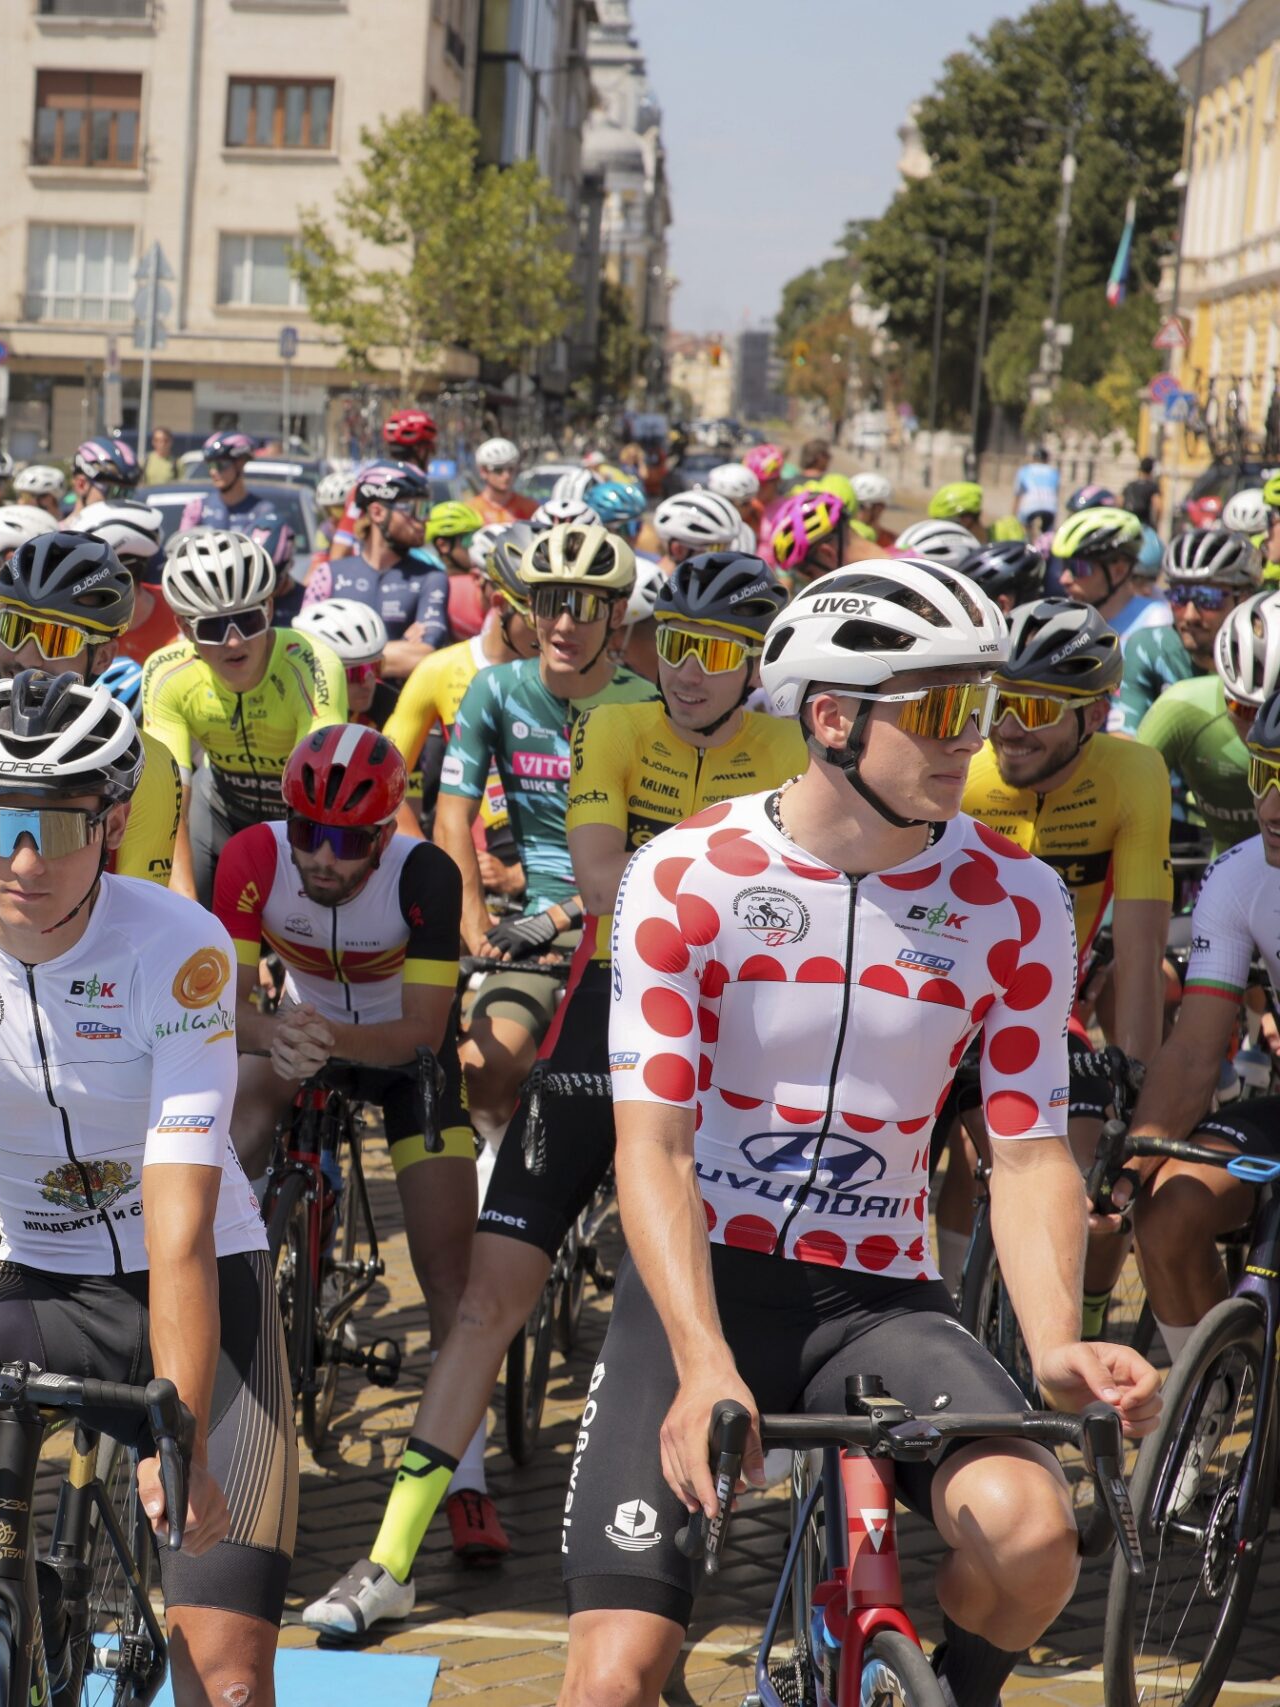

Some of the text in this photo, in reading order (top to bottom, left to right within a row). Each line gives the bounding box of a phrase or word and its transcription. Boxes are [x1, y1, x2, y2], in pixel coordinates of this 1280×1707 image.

[812, 596, 876, 618] uvex
[979, 643, 999, 653] uvex
[518, 755, 570, 780] VITO
[640, 776, 680, 799] KALINEL
[630, 794, 677, 816] Continental
[894, 922, 969, 944] Bulgarian Cycling Federation
[898, 962, 946, 977] SPORT
[900, 950, 954, 969] DIEM
[610, 1053, 639, 1064] IEM
[161, 1116, 213, 1128] DIEM
[22, 1213, 105, 1234] МЛАДЕЖТА
[113, 1209, 127, 1221] И
[1245, 1265, 1279, 1278] SCOTT
[1108, 1477, 1144, 1565] SRAM
